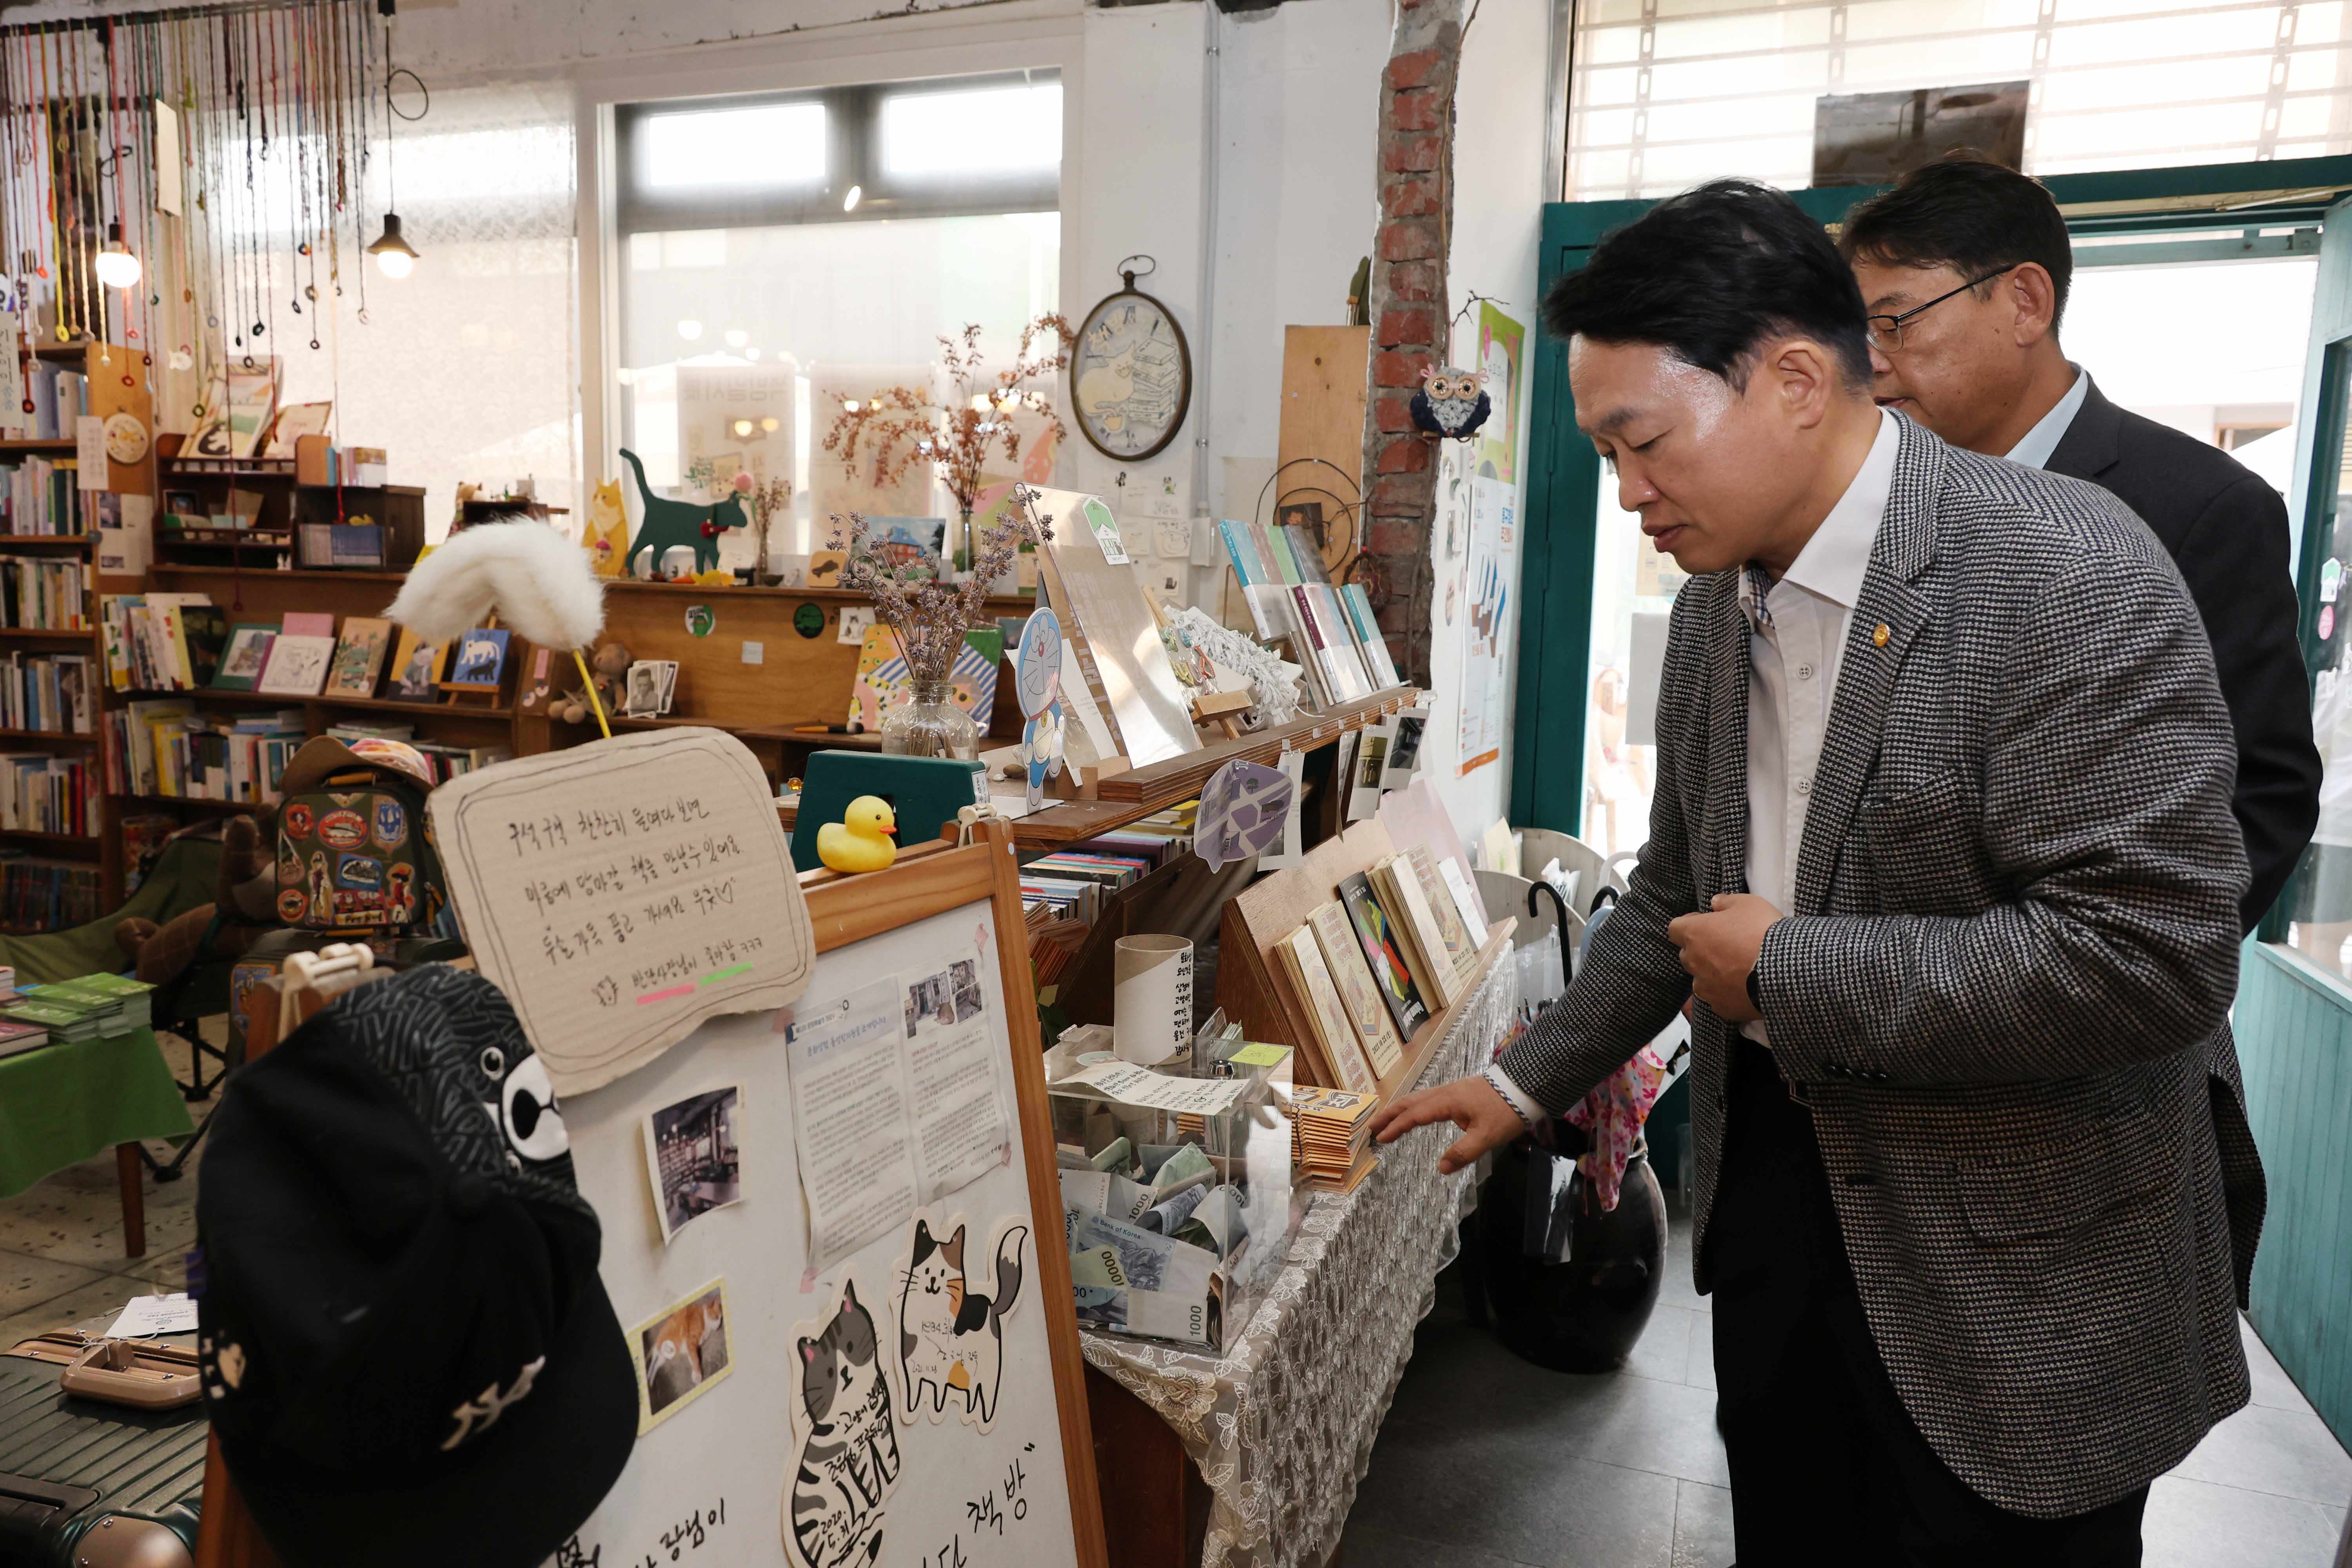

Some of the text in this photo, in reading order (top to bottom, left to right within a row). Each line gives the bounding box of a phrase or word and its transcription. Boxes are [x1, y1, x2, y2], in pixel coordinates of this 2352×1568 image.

[631, 855, 658, 884] 책을
[1174, 1030, 1185, 1042] 물건
[1129, 1193, 1149, 1220] 1000
[1100, 1219, 1114, 1230] Bank
[1123, 1229, 1142, 1240] Korea
[1101, 1251, 1125, 1286] 10000
[1189, 1305, 1202, 1336] 1000
